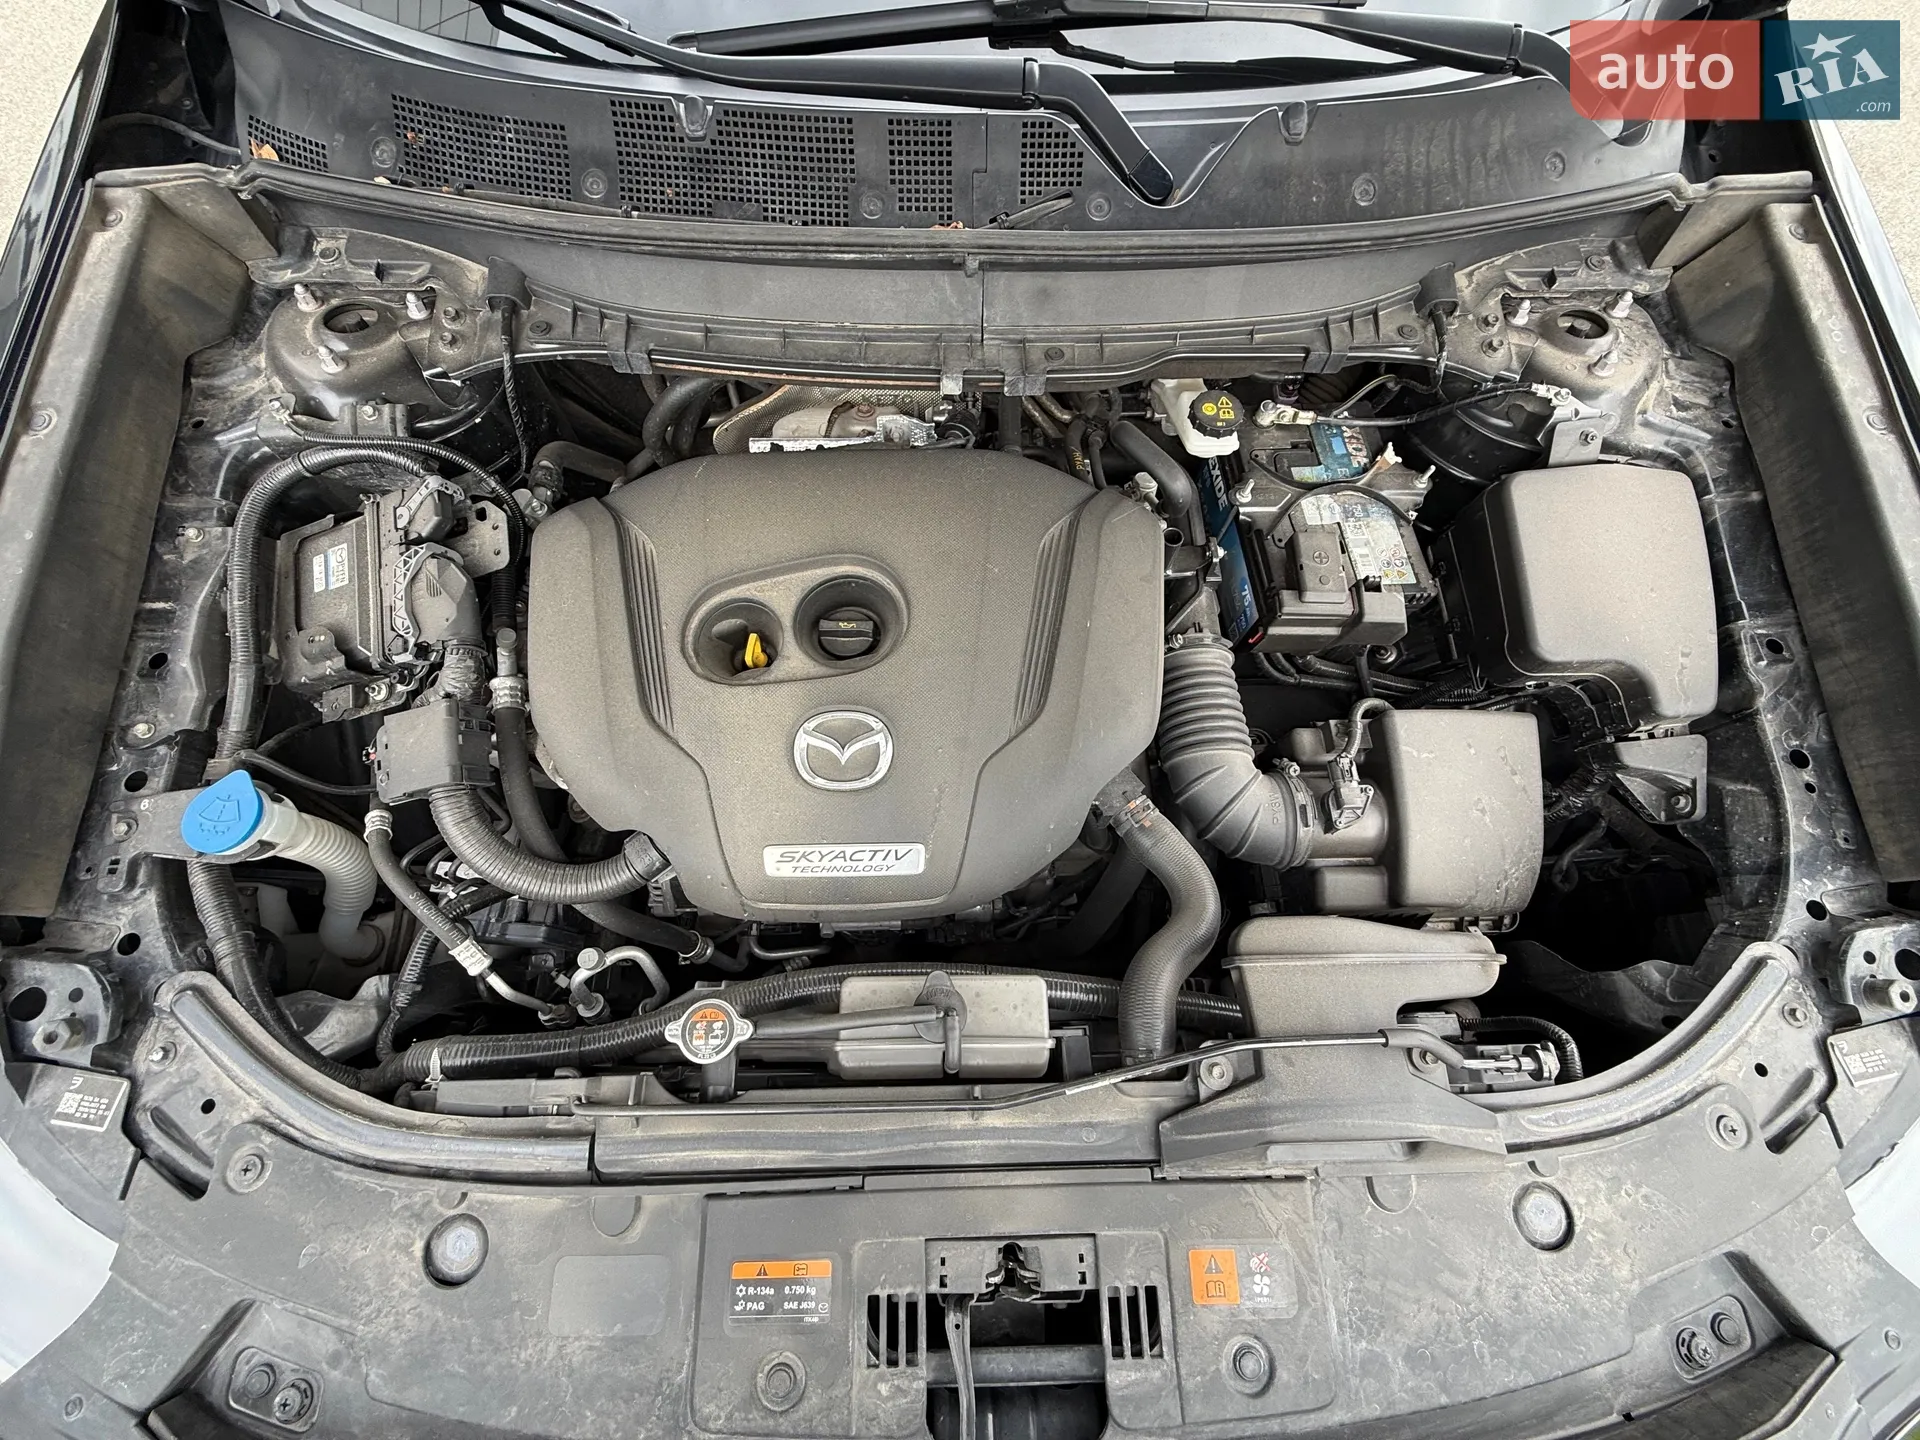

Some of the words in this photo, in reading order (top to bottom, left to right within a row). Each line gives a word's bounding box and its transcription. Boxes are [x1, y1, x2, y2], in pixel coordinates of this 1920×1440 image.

[1341, 425, 1370, 468] XIDE
[1208, 456, 1228, 512] EXIDE
[776, 849, 913, 863] SKYACTIV
[792, 864, 895, 874] TECHNOLOGY
[747, 1286, 775, 1295] R-134a
[784, 1285, 805, 1295] 0.750
[806, 1284, 817, 1296] kg
[746, 1301, 765, 1311] PAG
[783, 1301, 799, 1310] SAE
[799, 1301, 816, 1309] J639
